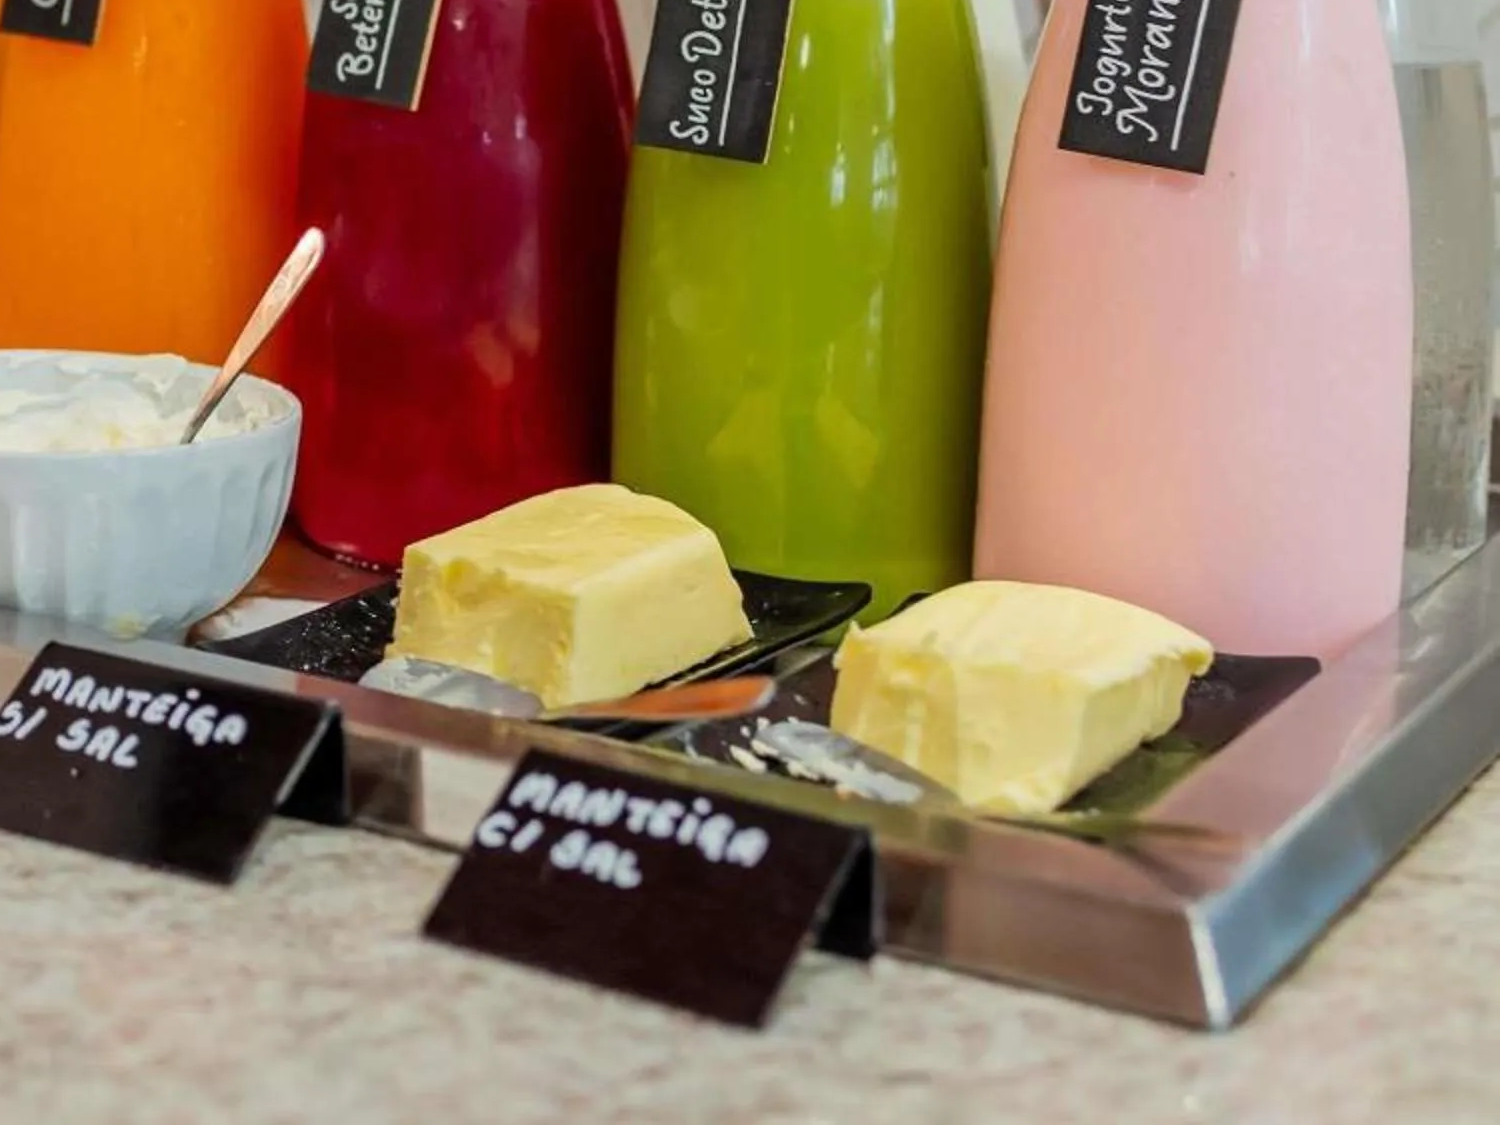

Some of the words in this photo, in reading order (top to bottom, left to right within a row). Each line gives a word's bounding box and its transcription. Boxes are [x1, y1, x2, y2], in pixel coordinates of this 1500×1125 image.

[669, 69, 716, 145] Suco
[56, 717, 139, 768] SAL
[476, 809, 545, 853] C/
[548, 828, 643, 890] SAL
